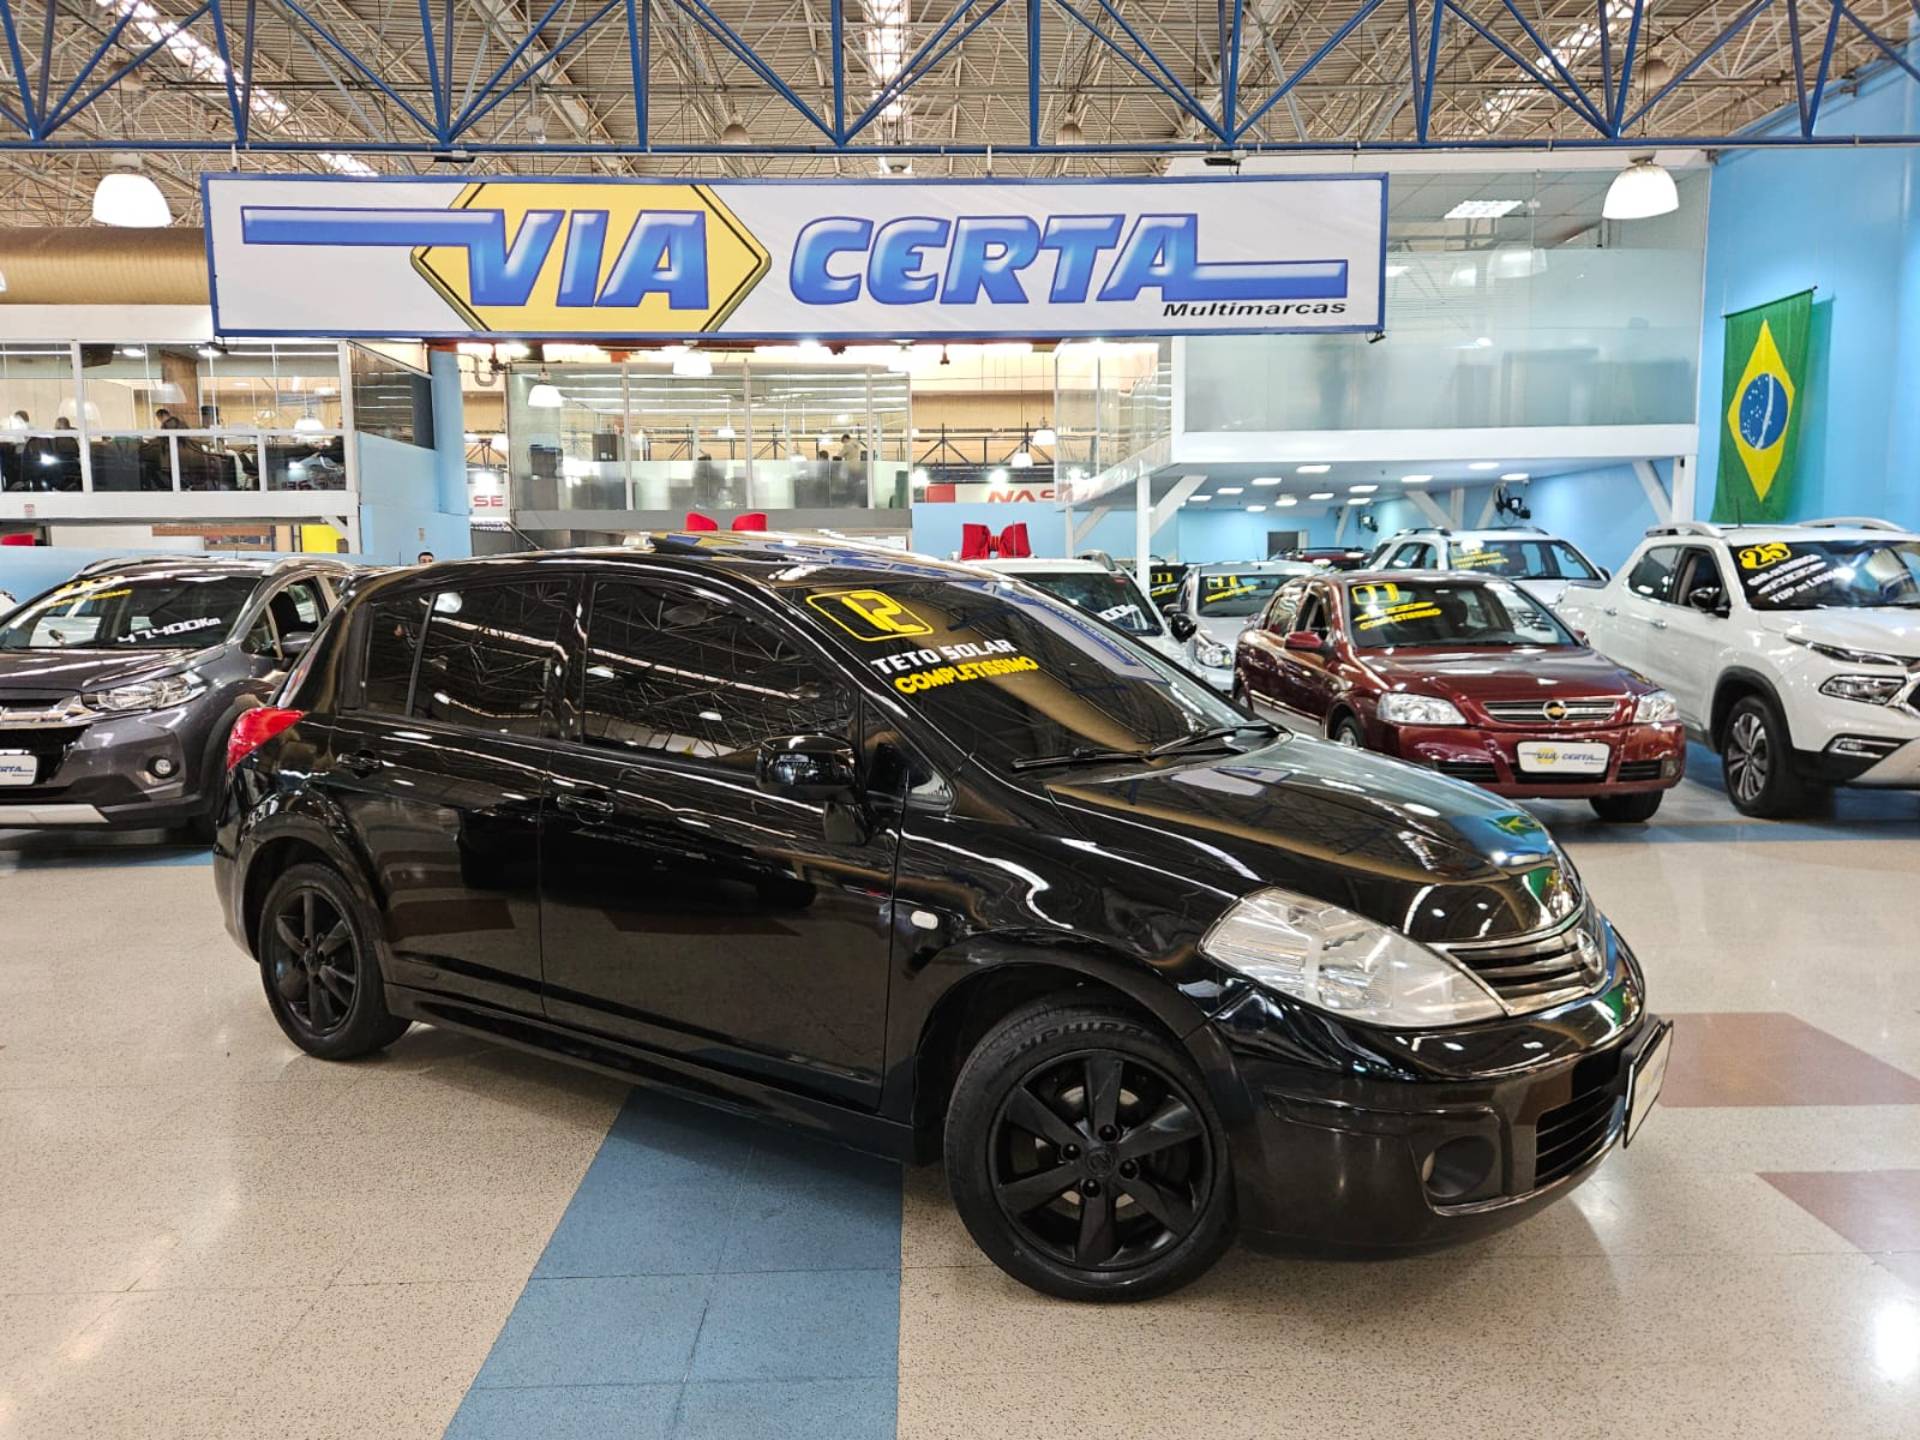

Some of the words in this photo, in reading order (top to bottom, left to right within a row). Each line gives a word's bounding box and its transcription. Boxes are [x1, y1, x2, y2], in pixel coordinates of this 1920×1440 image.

[468, 211, 709, 307] VIA
[790, 215, 1198, 303] CERTA
[1163, 302, 1347, 317] Multimarcas
[1738, 541, 1792, 569] 25
[841, 593, 925, 633] 12
[870, 649, 941, 675] TETO
[940, 639, 1018, 660] SOLAR
[894, 656, 1039, 694] COMPLETISSIMO
